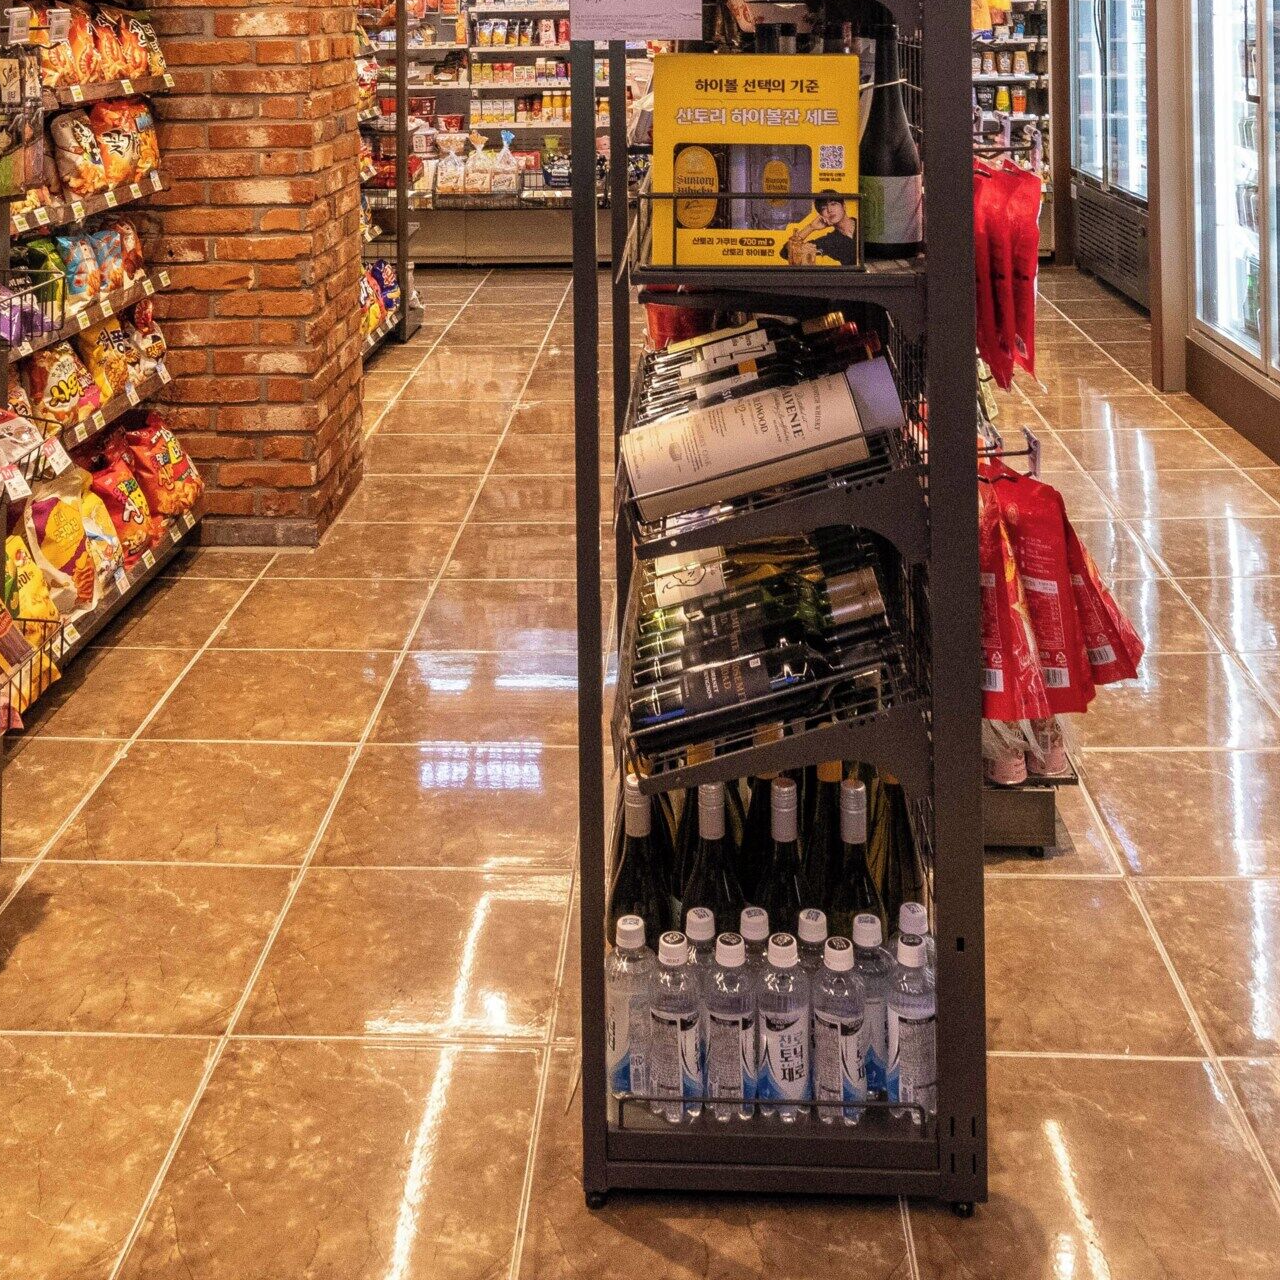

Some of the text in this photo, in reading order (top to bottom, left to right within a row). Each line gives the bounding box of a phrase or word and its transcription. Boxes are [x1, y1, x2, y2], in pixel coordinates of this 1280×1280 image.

[694, 78, 820, 94] 하이볼 선택의 기준
[676, 107, 839, 127] 산토리 하이볼잔 세트
[742, 238, 757, 246] 700
[722, 248, 775, 257] 산토리 하이볼잔
[779, 1046, 805, 1065] 토닉
[780, 1066, 806, 1082] 제로
